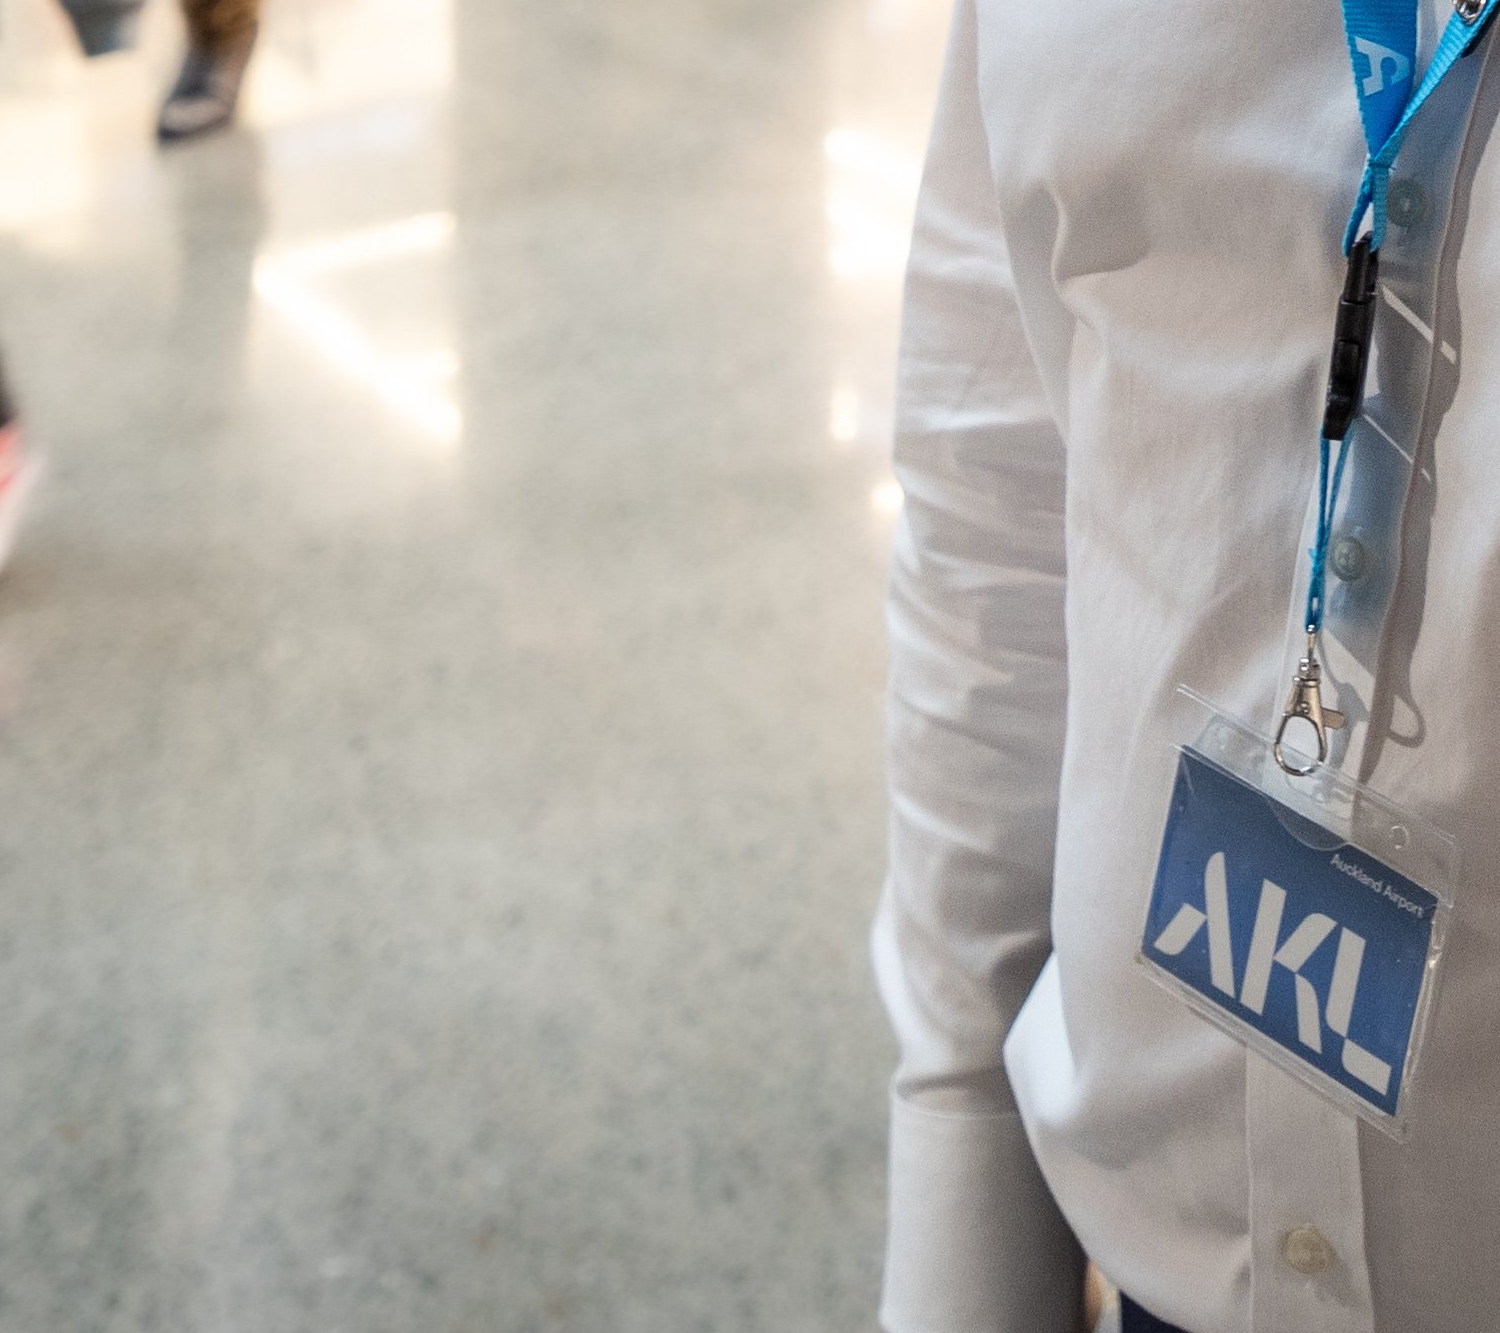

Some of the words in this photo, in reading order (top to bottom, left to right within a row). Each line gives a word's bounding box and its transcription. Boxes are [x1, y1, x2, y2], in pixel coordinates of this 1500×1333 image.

[1330, 853, 1383, 893] Auckland
[1383, 884, 1425, 919] Airport
[1154, 850, 1393, 1097] AKL
